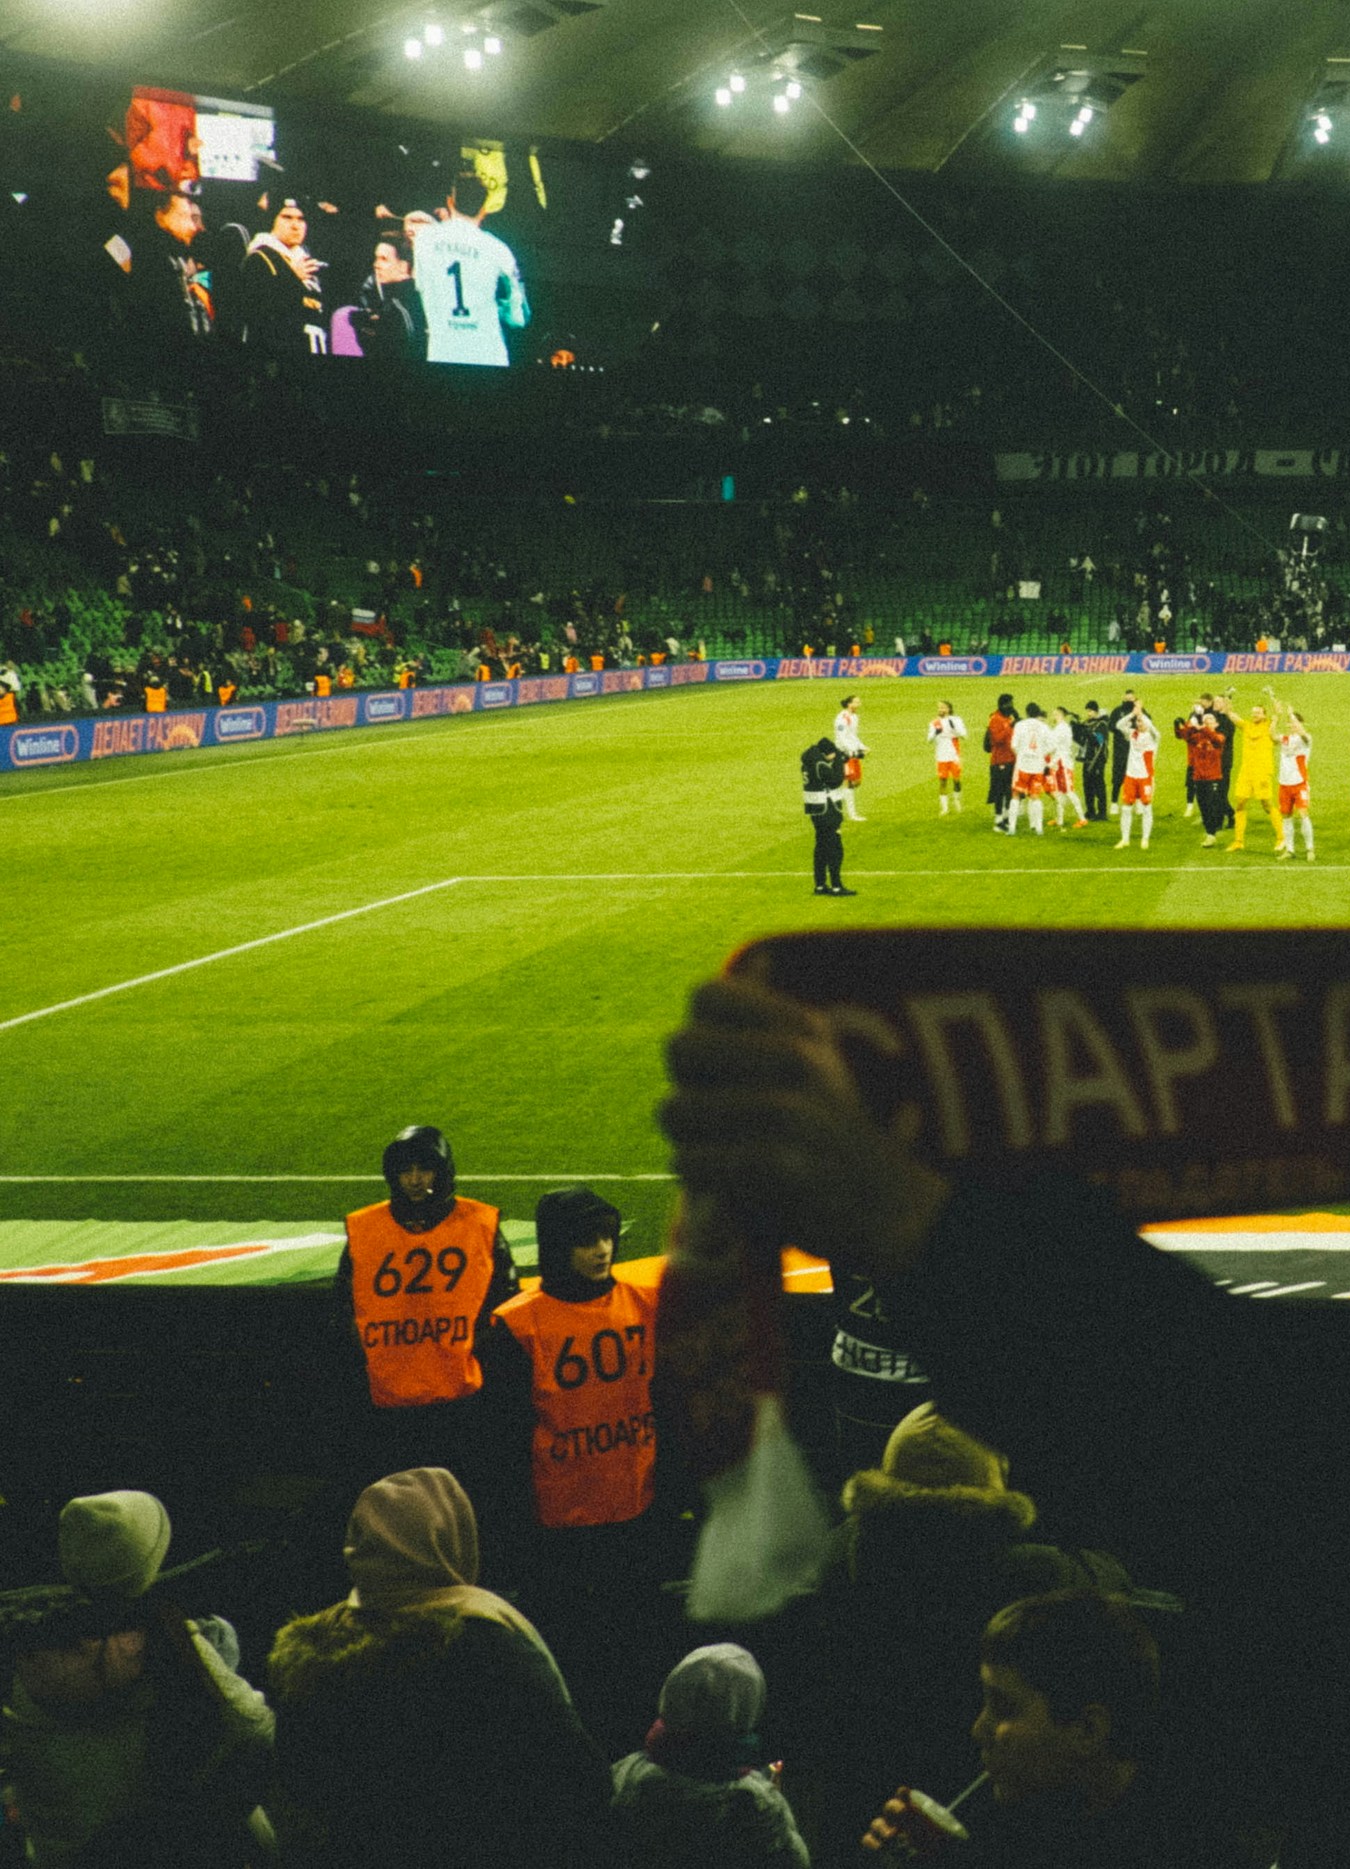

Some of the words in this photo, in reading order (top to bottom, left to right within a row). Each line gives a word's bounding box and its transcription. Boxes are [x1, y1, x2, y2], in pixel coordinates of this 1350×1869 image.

[447, 261, 470, 316] 1
[926, 661, 967, 672] Winline
[1000, 656, 1061, 676] ДЕЛАЕТ
[1061, 655, 1130, 674] РАЗНИЦУ
[1149, 658, 1191, 670] Winline
[1222, 653, 1283, 673] ДЕЛАЕТ
[16, 736, 60, 757] Winline
[373, 1247, 468, 1298] 629
[364, 1315, 469, 1348] СТЮАРД
[554, 1326, 646, 1390] 607
